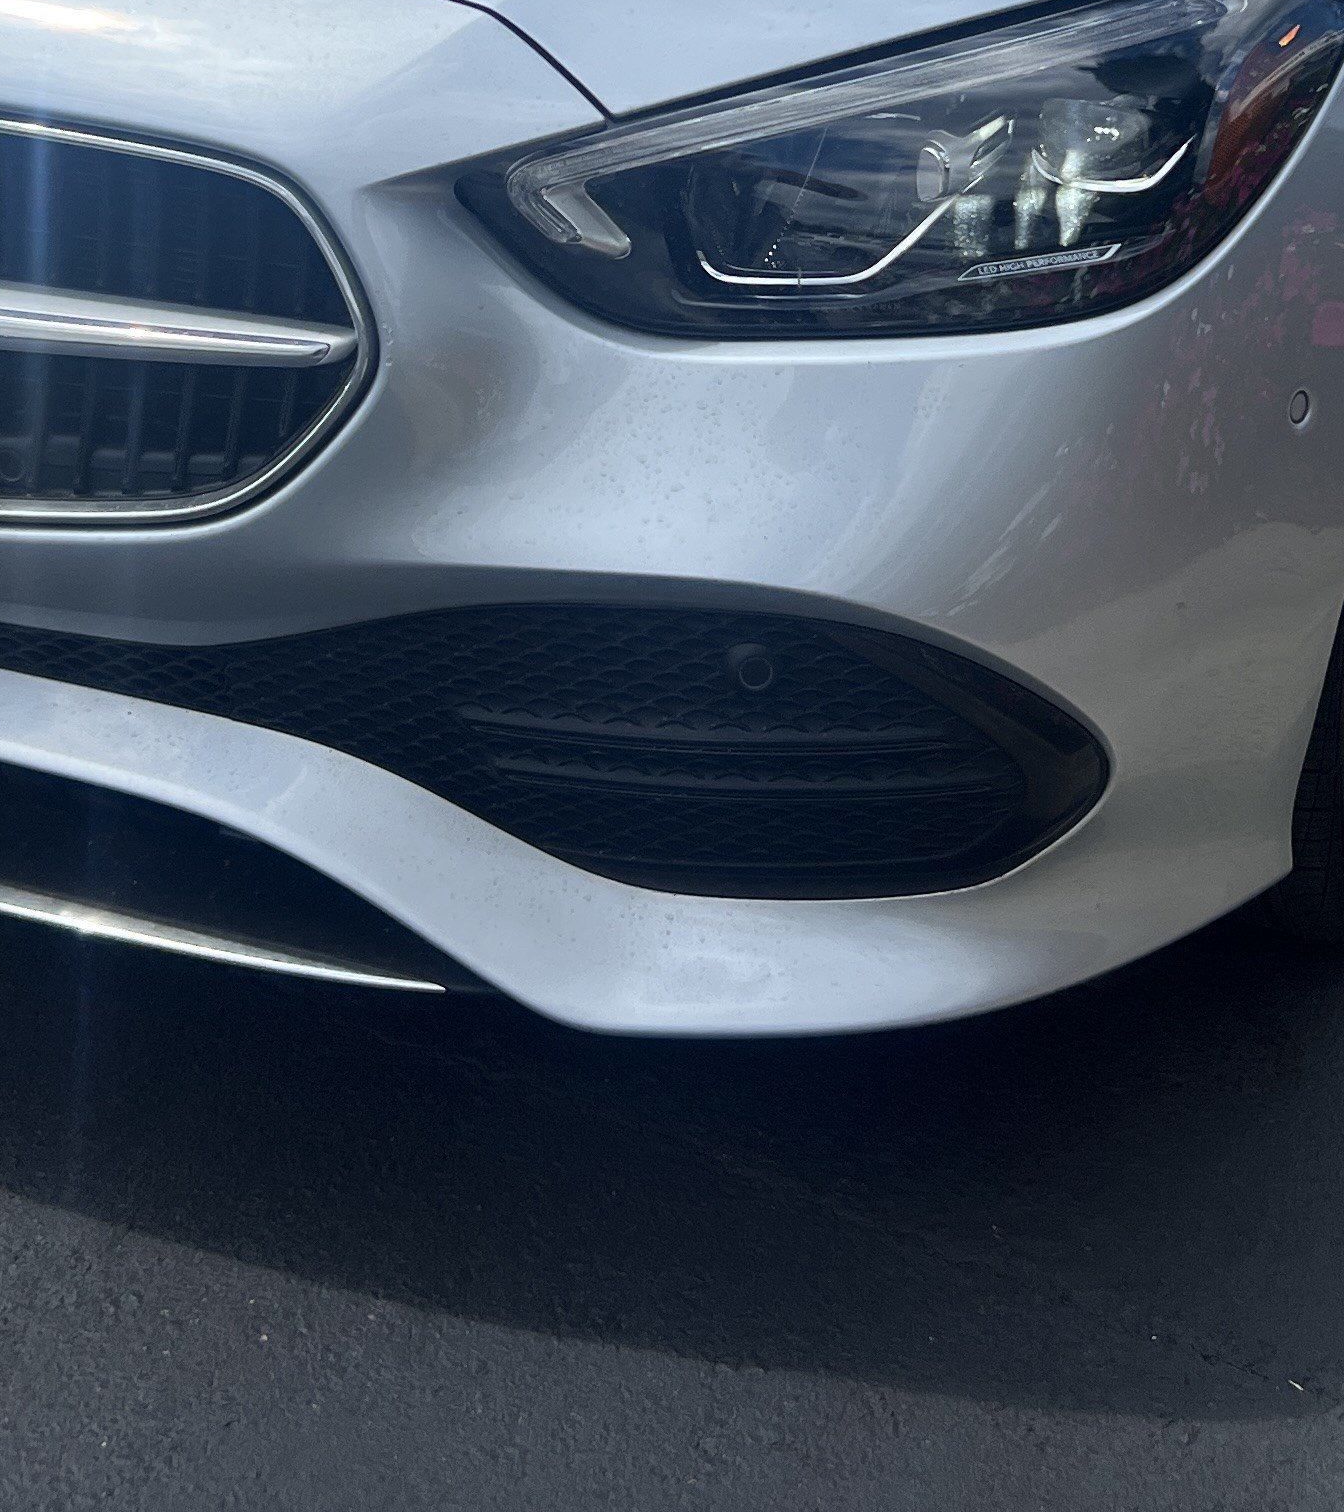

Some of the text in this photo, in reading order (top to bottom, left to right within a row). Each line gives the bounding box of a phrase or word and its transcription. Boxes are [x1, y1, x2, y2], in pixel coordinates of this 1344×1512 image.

[978, 250, 1099, 275] LED HIGH PERFORMANCE
